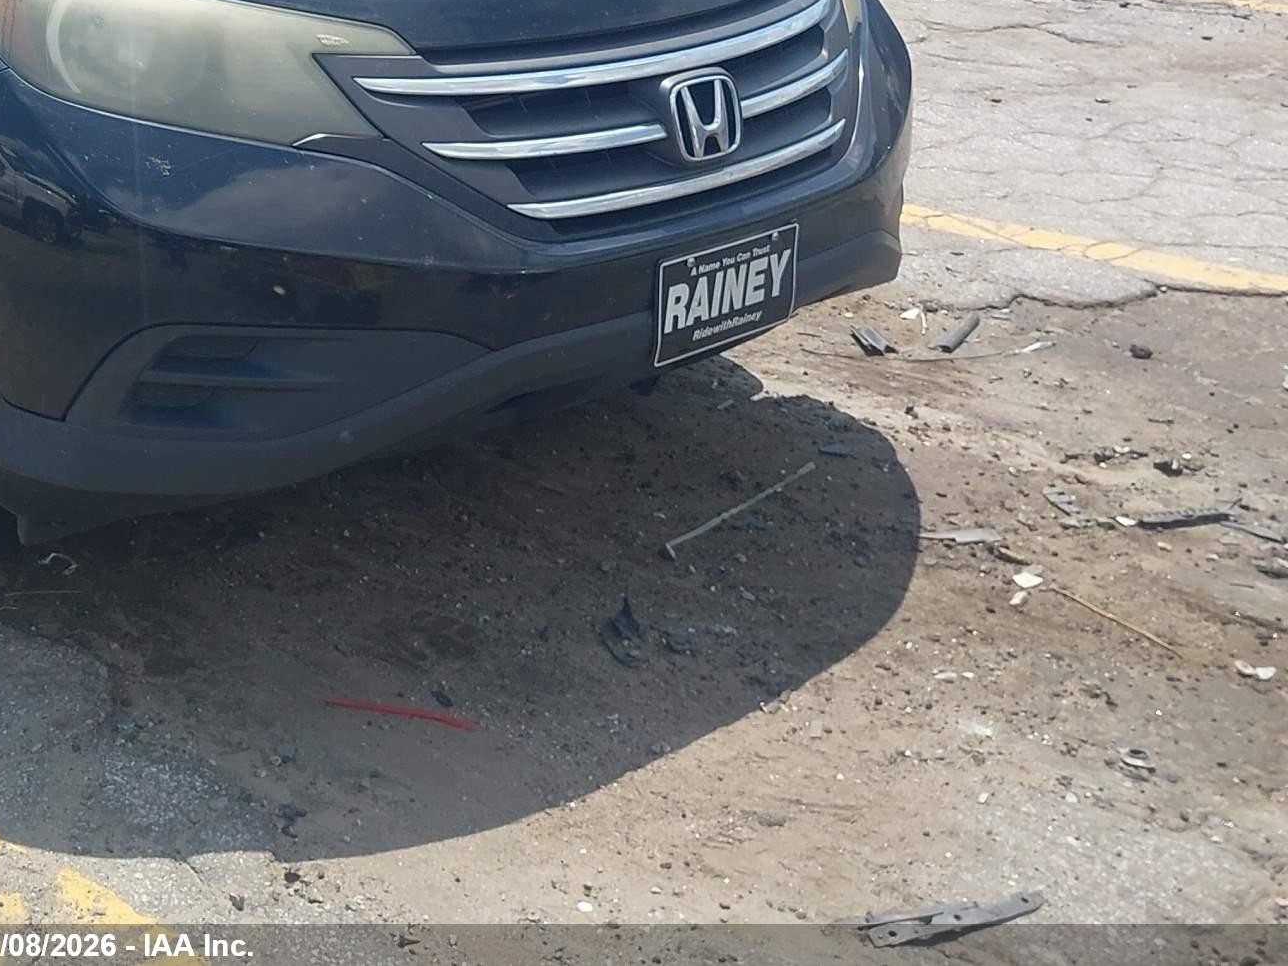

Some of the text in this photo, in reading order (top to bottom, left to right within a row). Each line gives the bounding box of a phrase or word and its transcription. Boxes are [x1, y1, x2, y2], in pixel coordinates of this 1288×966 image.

[698, 261, 721, 275] Name
[722, 256, 735, 267] You
[736, 251, 751, 263] Can
[752, 244, 771, 257] Trust
[663, 248, 792, 335] RAINEY
